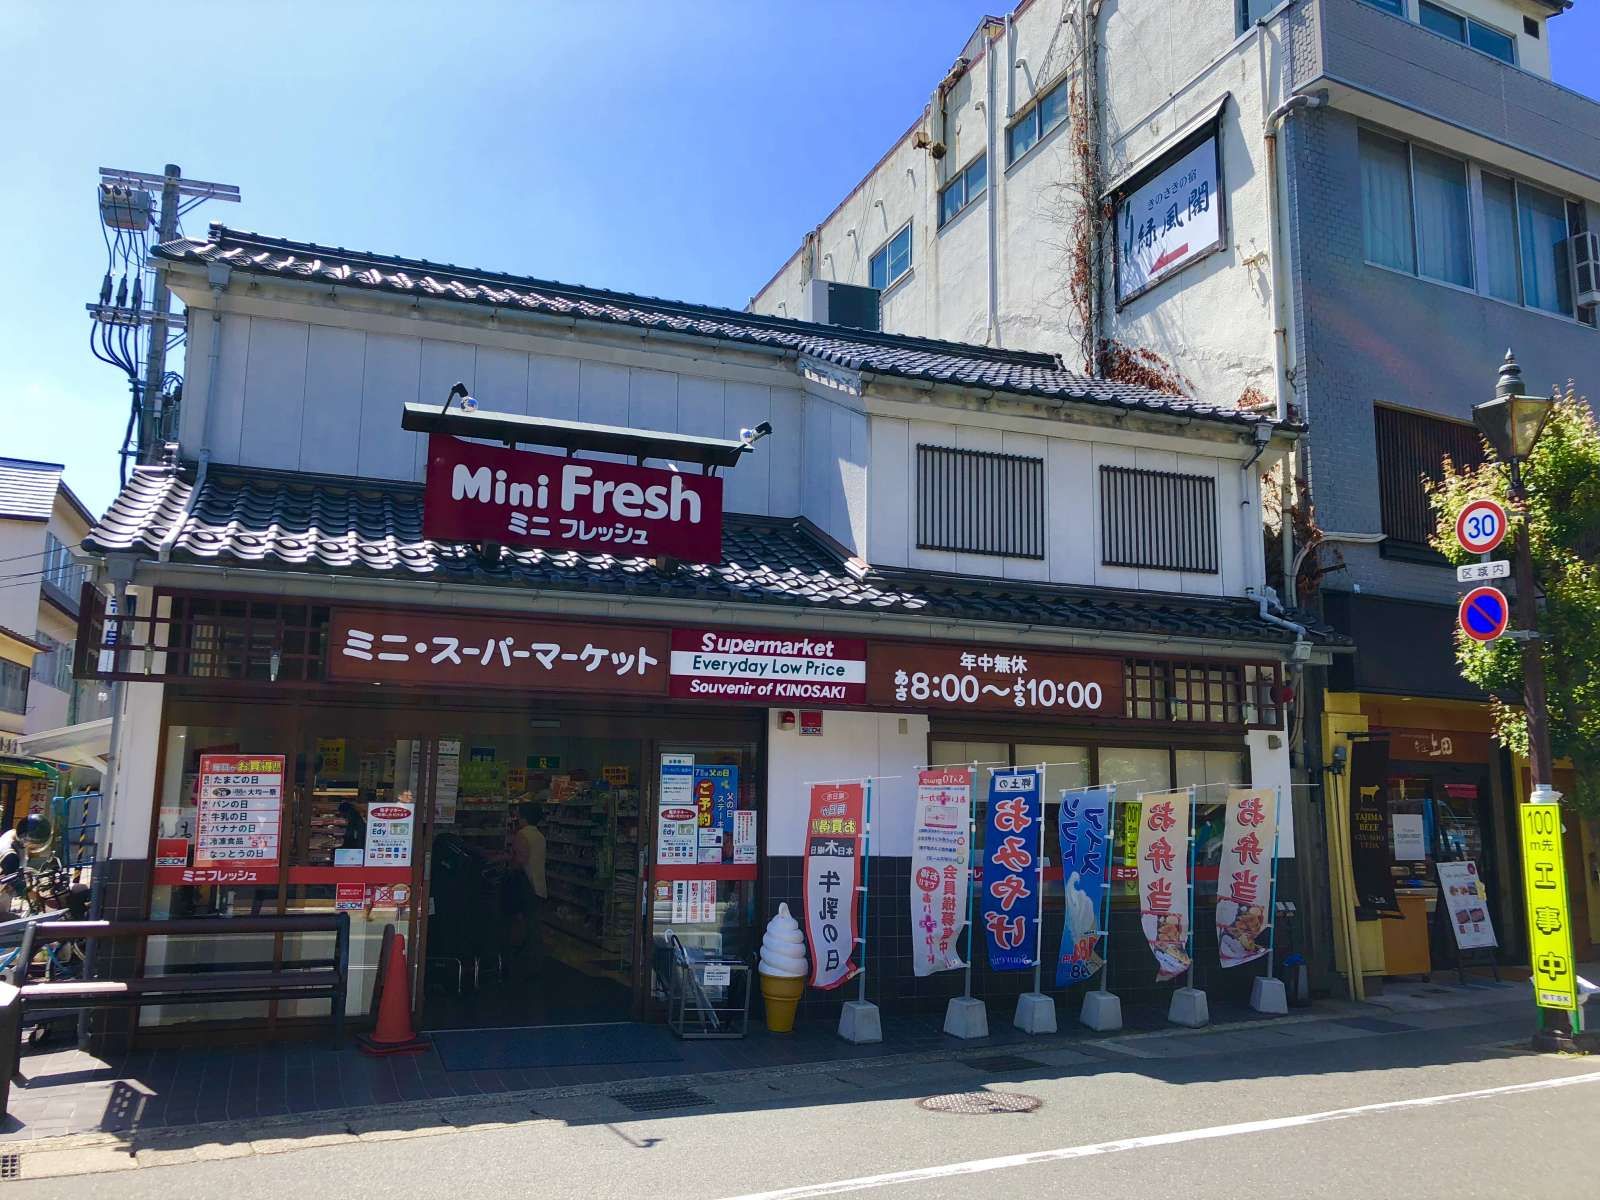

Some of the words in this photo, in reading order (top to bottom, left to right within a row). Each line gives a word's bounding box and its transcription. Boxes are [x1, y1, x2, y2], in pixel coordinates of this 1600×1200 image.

[451, 464, 549, 509] Mini
[561, 464, 702, 524] Fresh
[508, 512, 551, 536] ミニ
[559, 518, 649, 546] フレッシュ
[1468, 514, 1495, 539] 30
[1462, 564, 1504, 579] 区域内
[342, 629, 658, 675] ミニ・スーパーマーケット
[701, 632, 834, 658] Supermarket
[692, 655, 768, 675] Everyday
[772, 658, 804, 675] Low
[806, 660, 845, 677] Price
[960, 652, 1028, 674] 年中無休
[689, 680, 755, 696] Souvenir
[757, 681, 773, 696] of
[775, 683, 846, 699] KINOSAKI
[1027, 678, 1102, 710] 10:00
[213, 775, 259, 784] たまごの日
[726, 792, 735, 818] 父の日
[210, 812, 248, 822] 牛乳の日
[1528, 810, 1553, 836] 100
[210, 824, 256, 833] バナナの日
[371, 827, 387, 837] Edy
[663, 828, 676, 837] Edy
[210, 849, 264, 858] なっとうの日
[182, 870, 257, 882] ミニフレッシュ
[1534, 862, 1568, 981] 工事中
